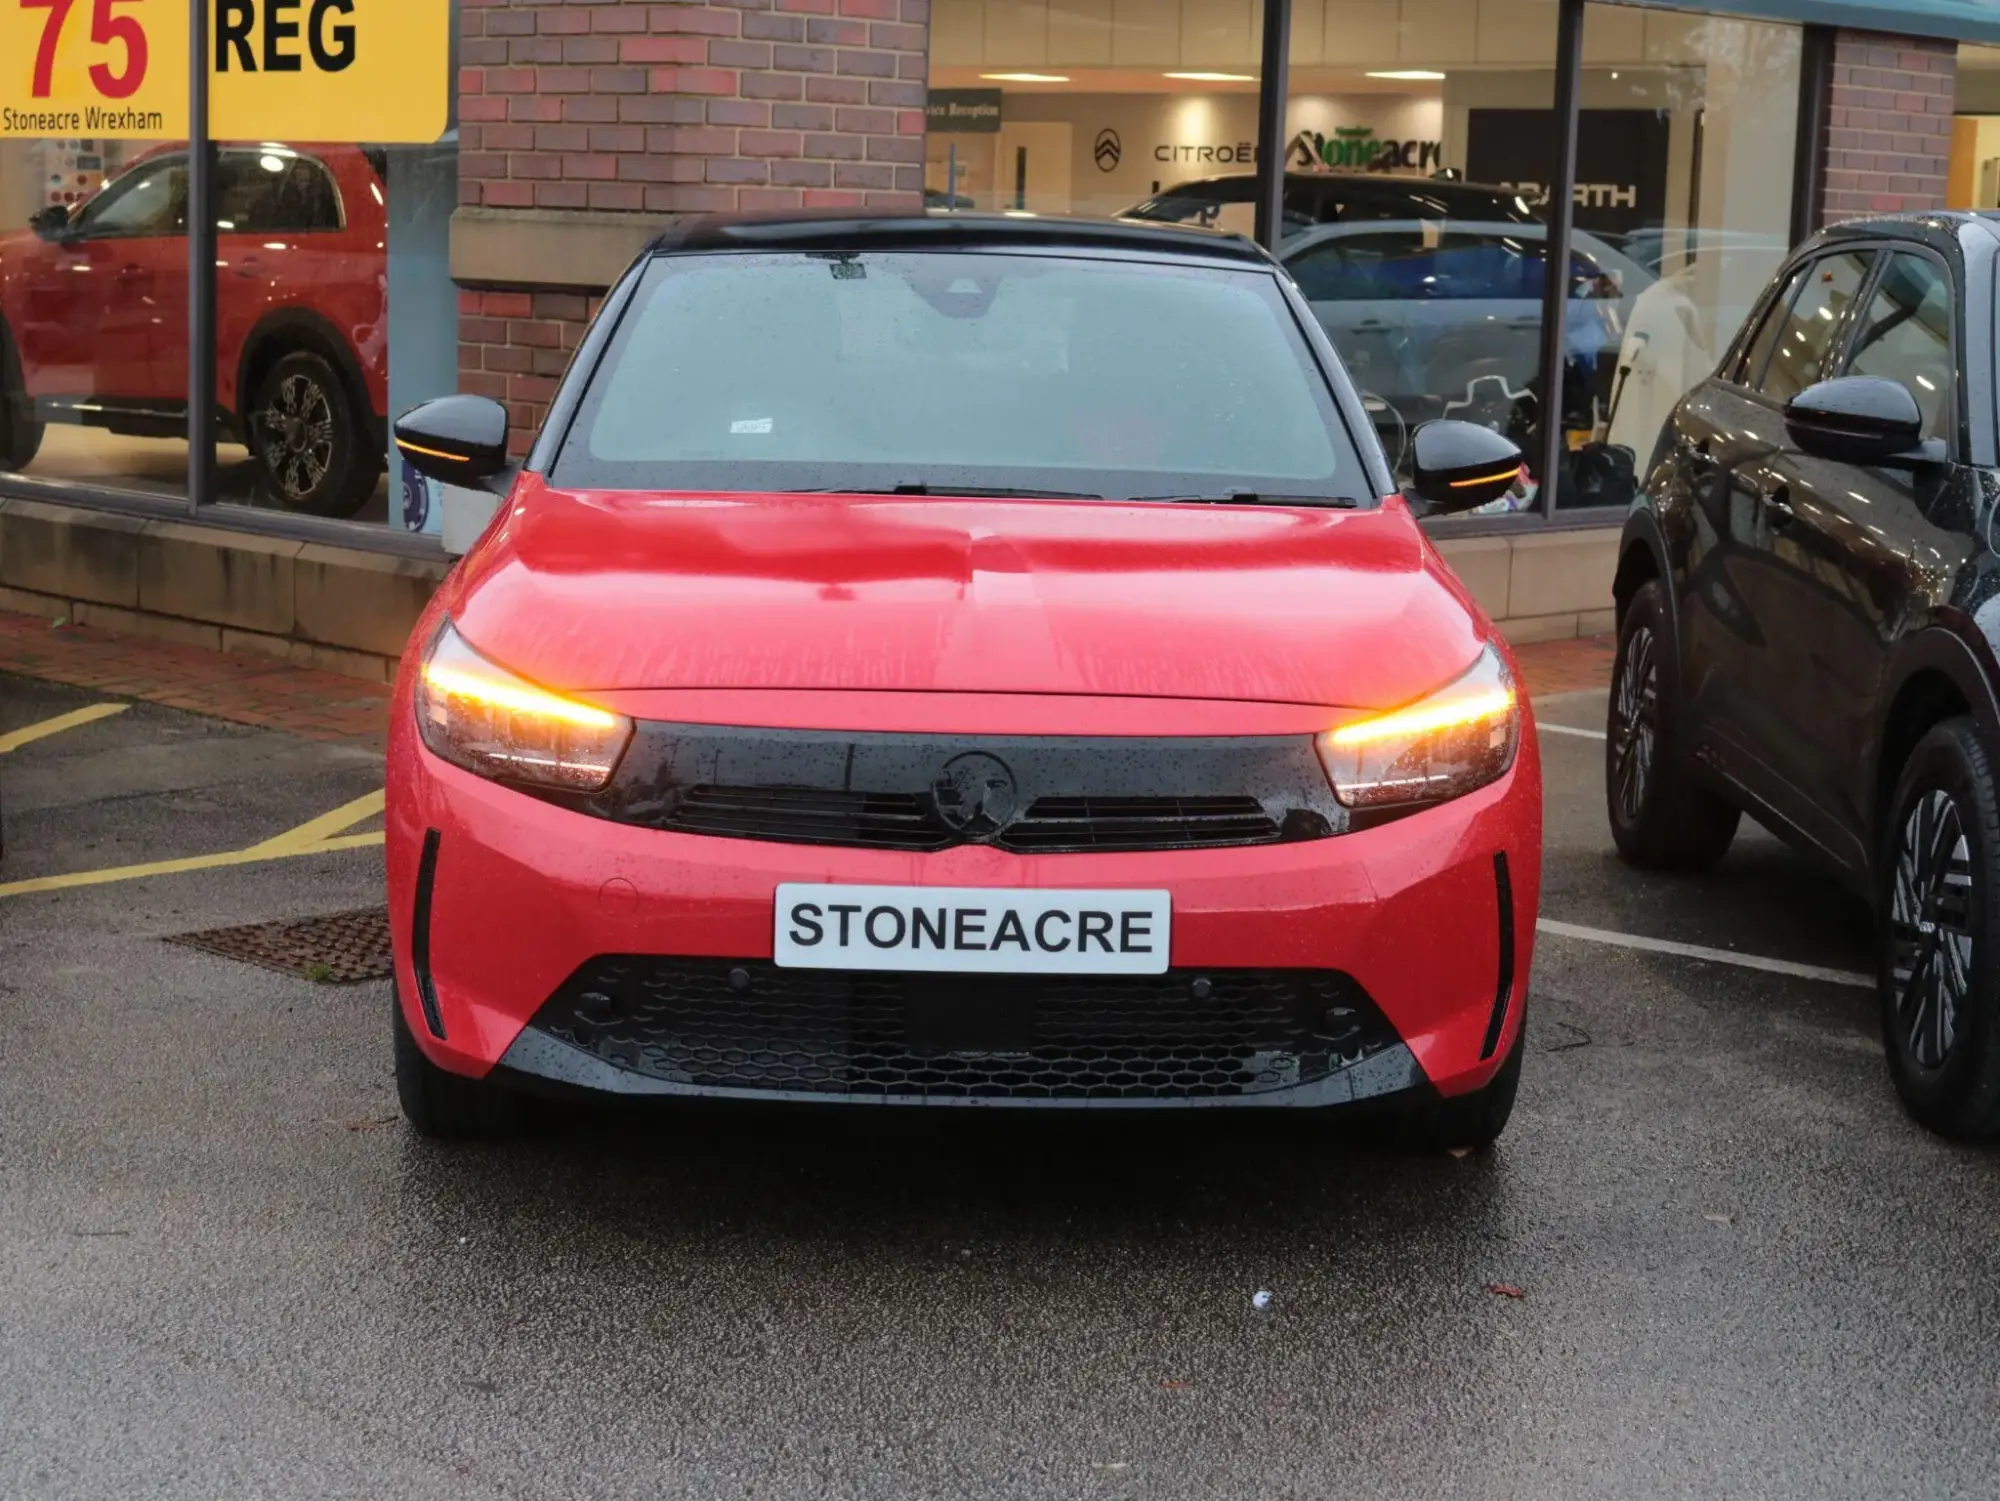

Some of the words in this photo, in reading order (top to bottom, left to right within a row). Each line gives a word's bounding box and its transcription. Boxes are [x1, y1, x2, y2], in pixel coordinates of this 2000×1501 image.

[20, 0, 148, 99] 75
[215, 0, 356, 72] REG
[3, 107, 79, 131] Stoneacre
[85, 105, 163, 130] Wrexham
[949, 102, 999, 119] Reception
[1154, 142, 1258, 163] CITROË
[789, 903, 1153, 953] STONEACRE
